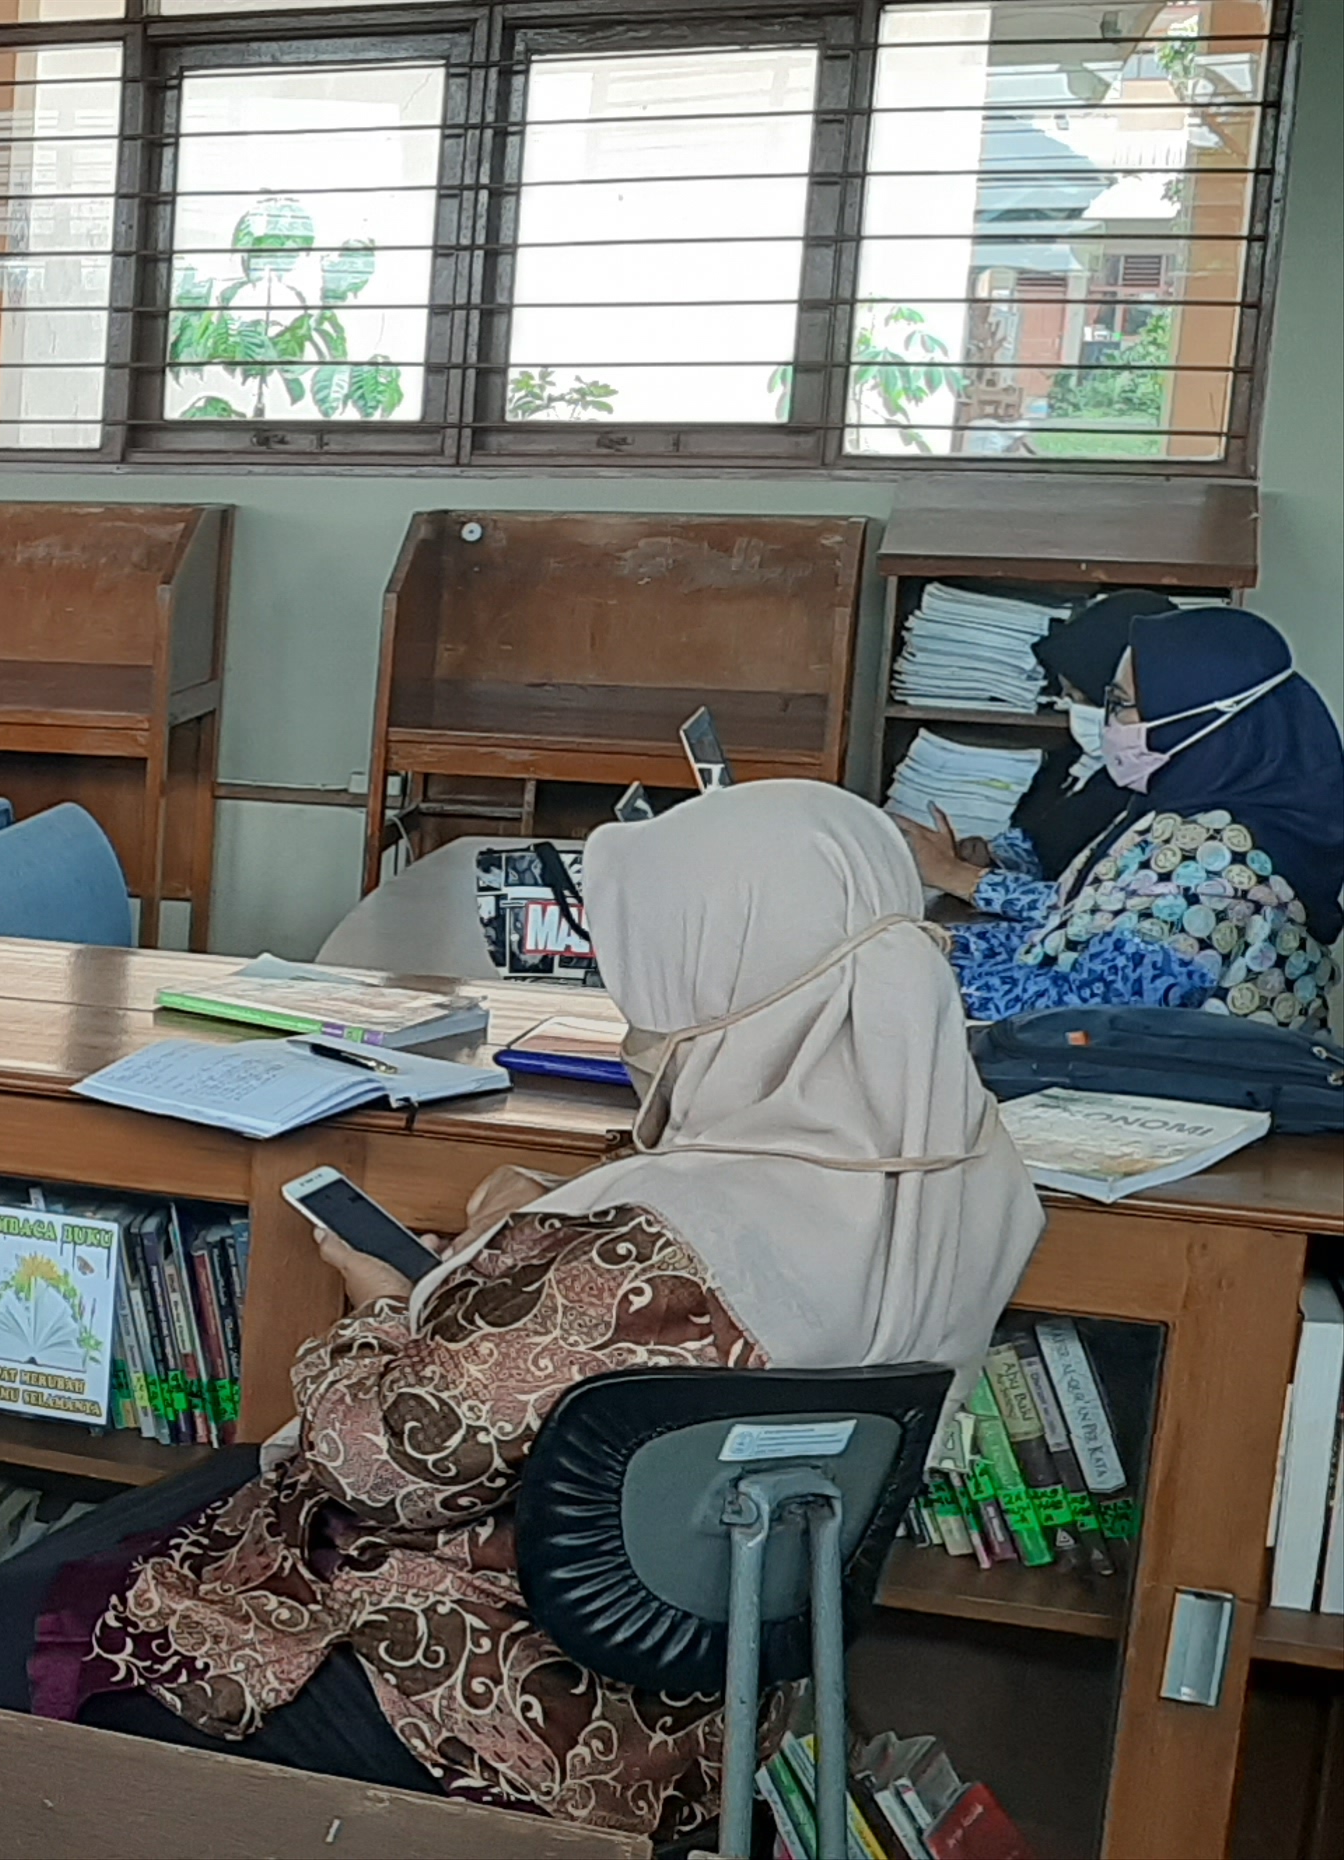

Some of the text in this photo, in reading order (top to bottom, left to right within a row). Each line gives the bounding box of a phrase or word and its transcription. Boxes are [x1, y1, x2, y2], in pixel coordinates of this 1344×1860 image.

[61, 1223, 113, 1248] BUKU
[21, 1369, 87, 1394] MERUBAH
[23, 1391, 102, 1417] SELAMANYA
[1089, 1442, 1110, 1478] KATA
